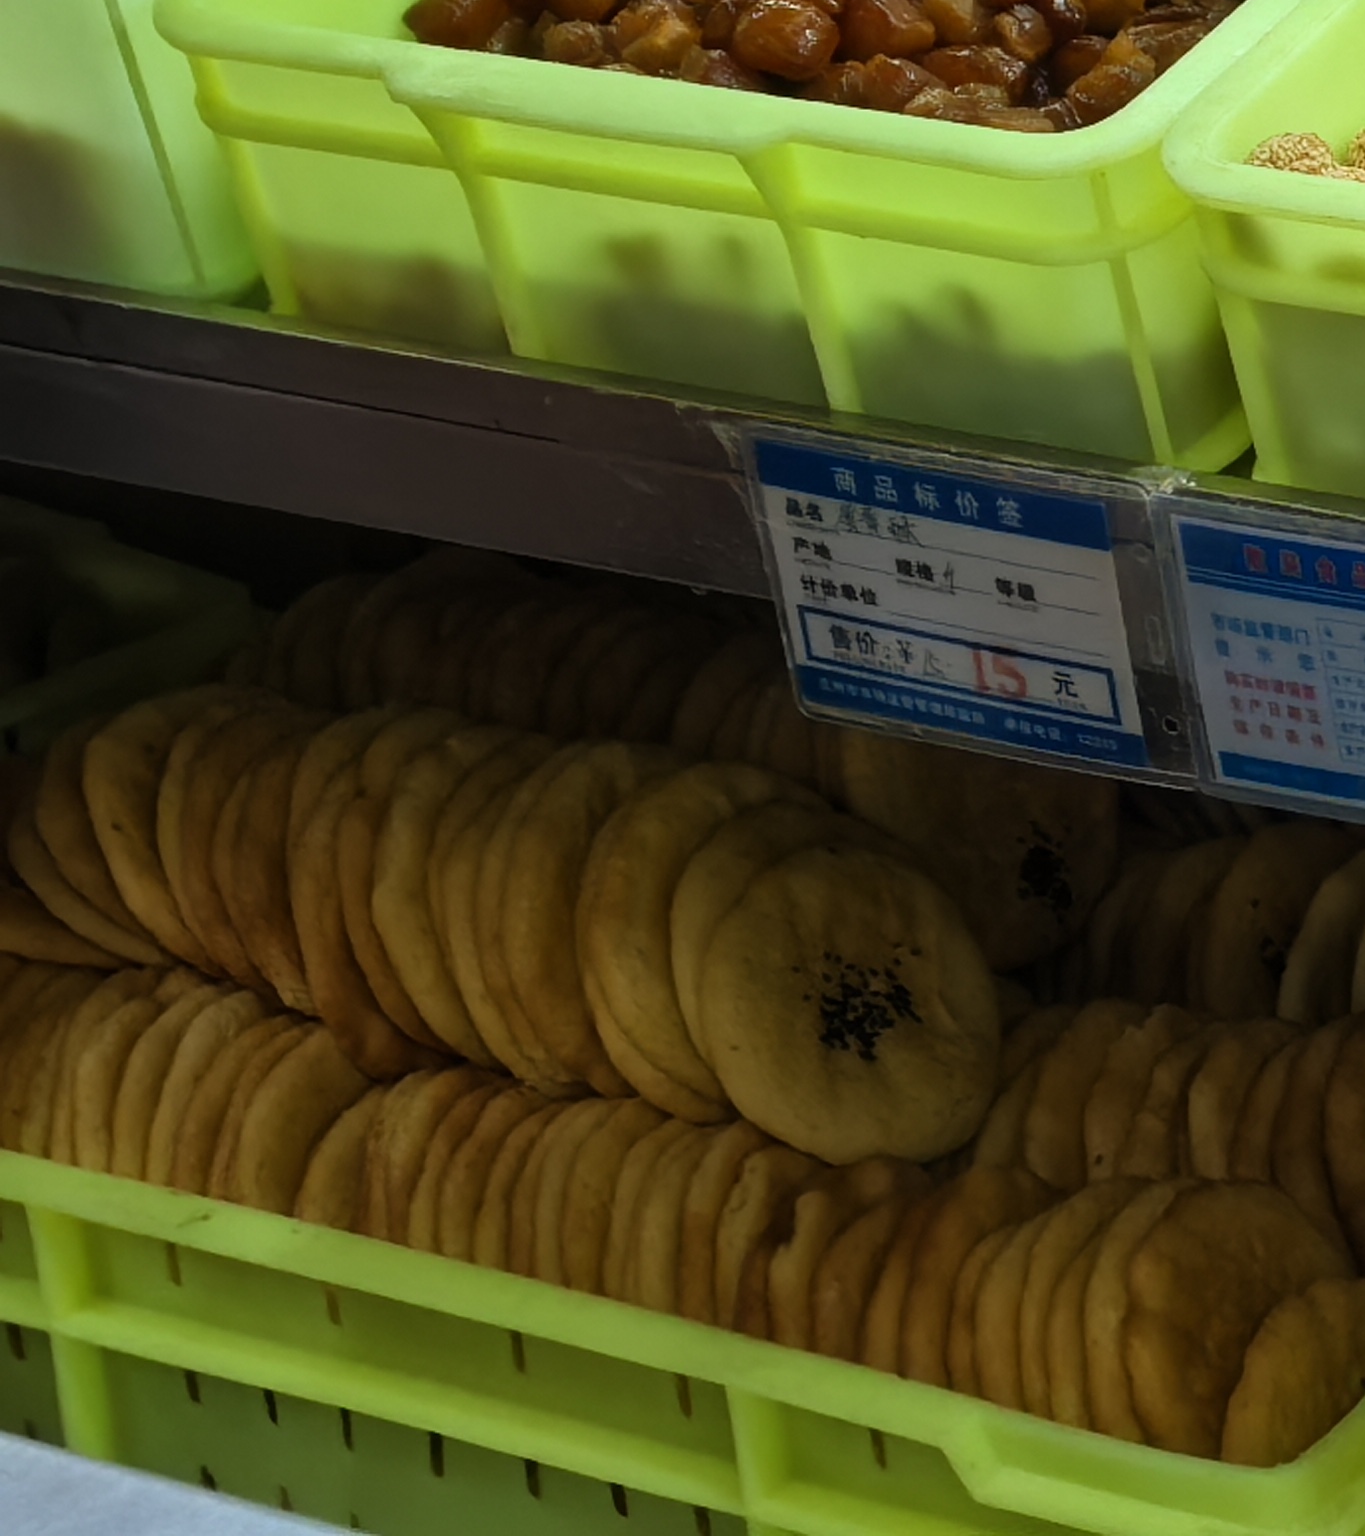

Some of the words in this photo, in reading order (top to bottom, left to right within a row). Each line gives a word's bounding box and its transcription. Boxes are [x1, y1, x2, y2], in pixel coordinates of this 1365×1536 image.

[829, 466, 1024, 529] 商品标价签
[972, 646, 1028, 700] 15
[1052, 671, 1079, 699] 元
